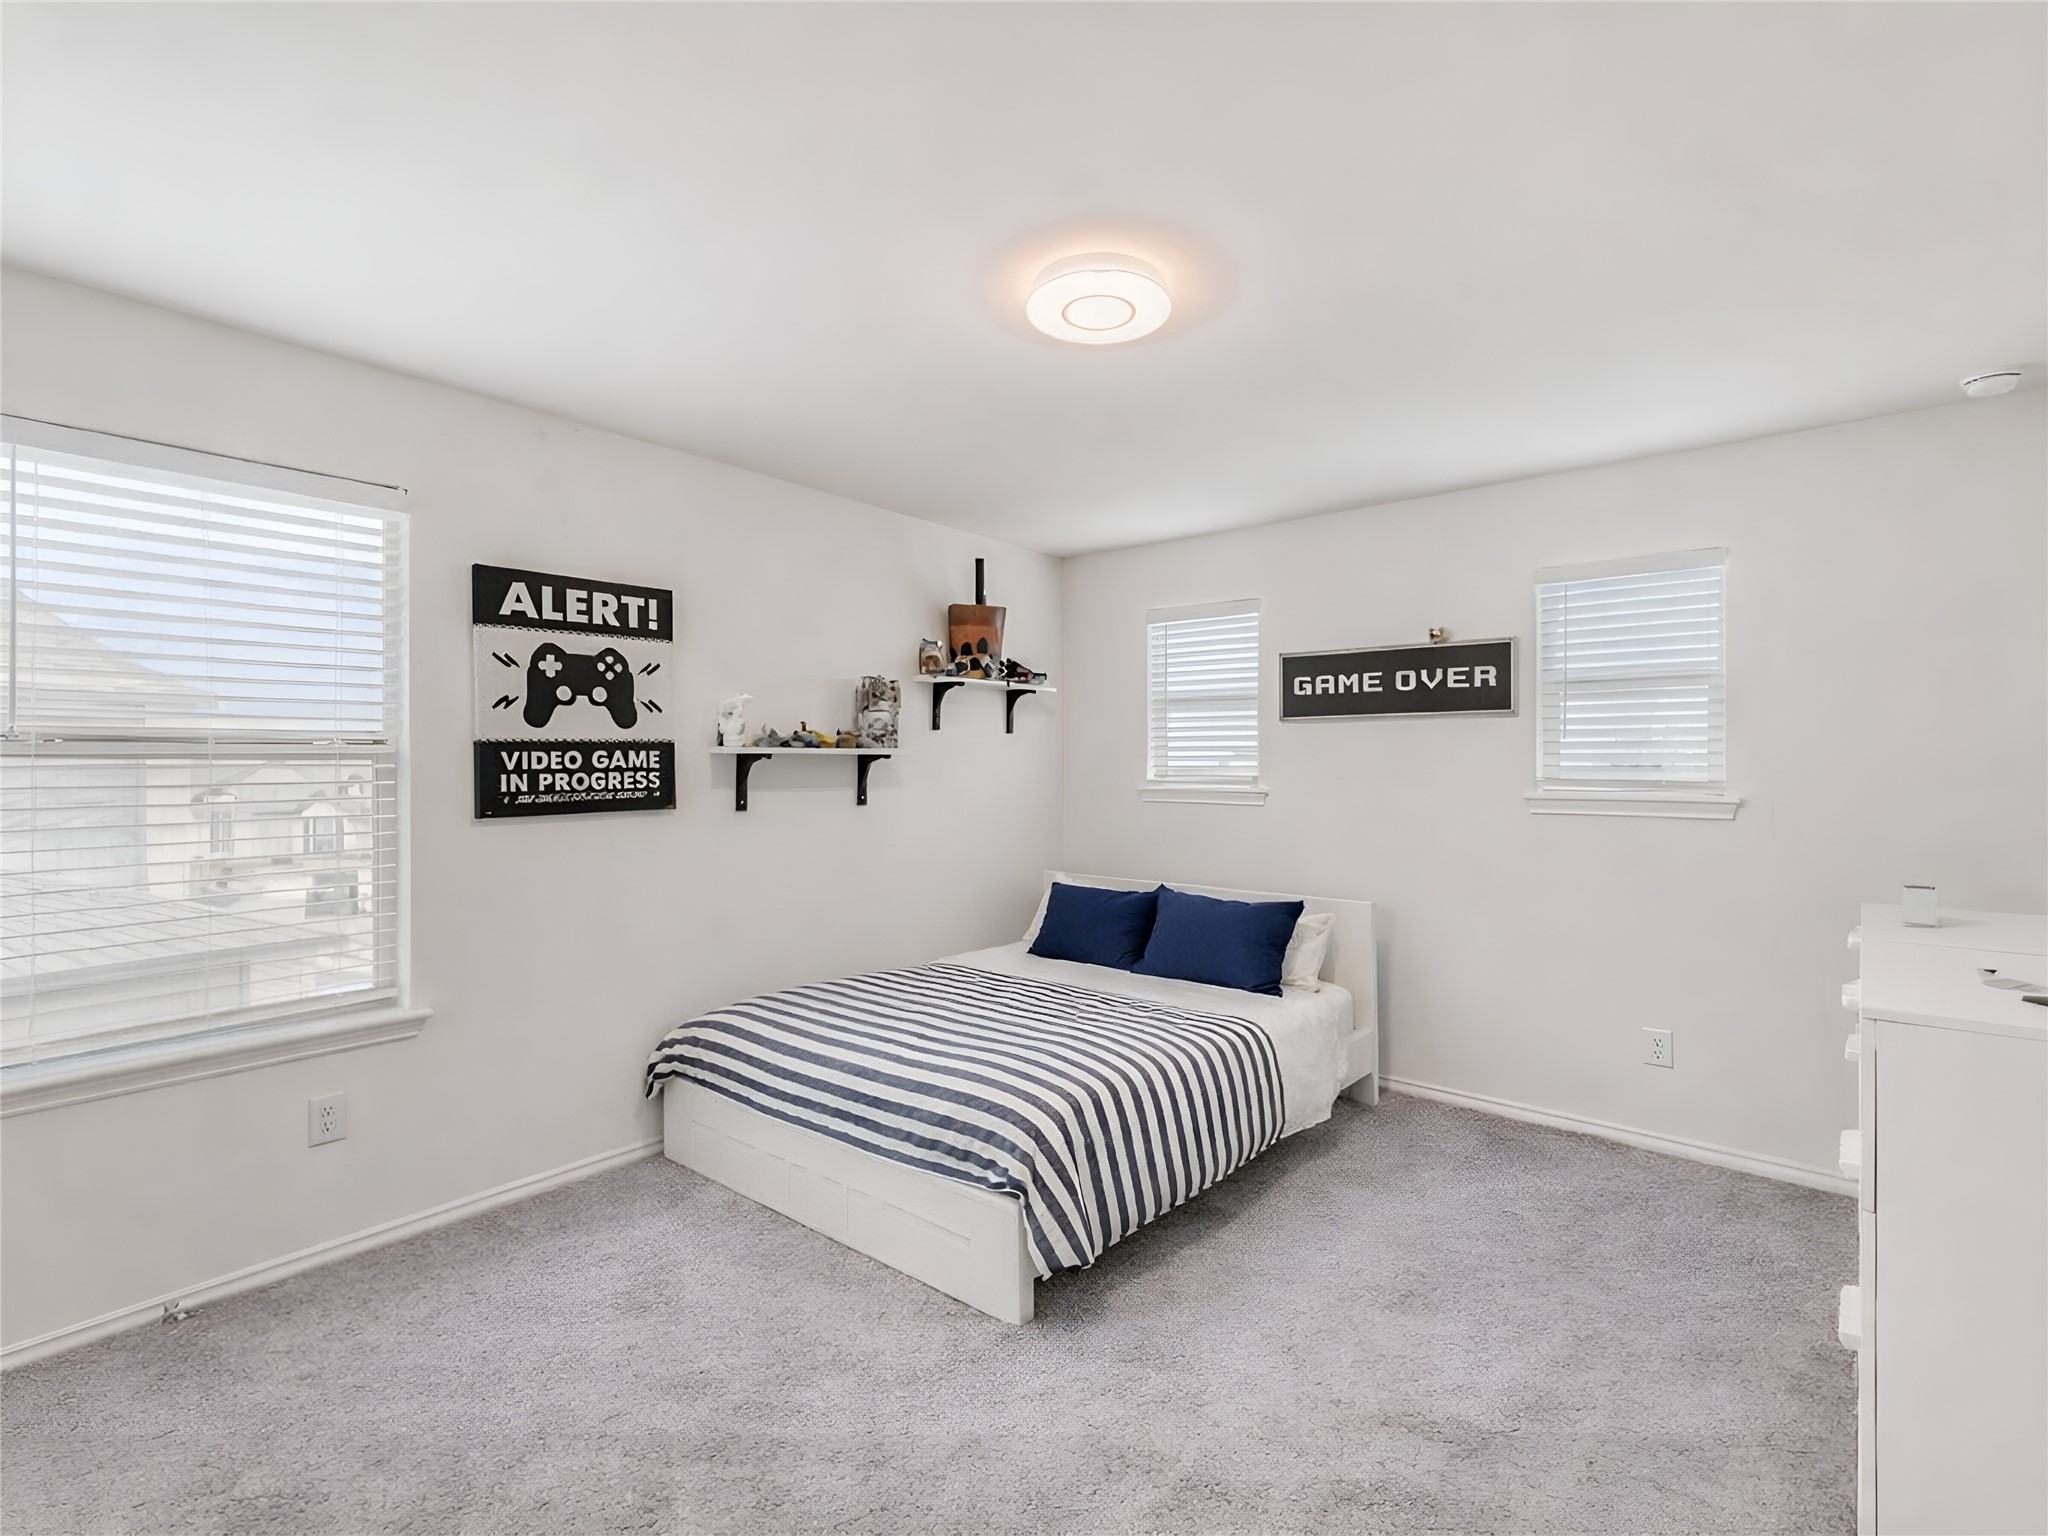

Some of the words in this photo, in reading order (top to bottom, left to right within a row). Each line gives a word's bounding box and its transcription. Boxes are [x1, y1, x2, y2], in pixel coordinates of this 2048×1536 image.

[499, 581, 658, 630] ALERT!
[1293, 671, 1383, 696] GAME
[1395, 665, 1497, 691] OVER
[500, 750, 583, 770] VIDEO
[591, 750, 660, 770] GAME
[500, 773, 528, 793] IN
[539, 771, 660, 792] PROGRESS
